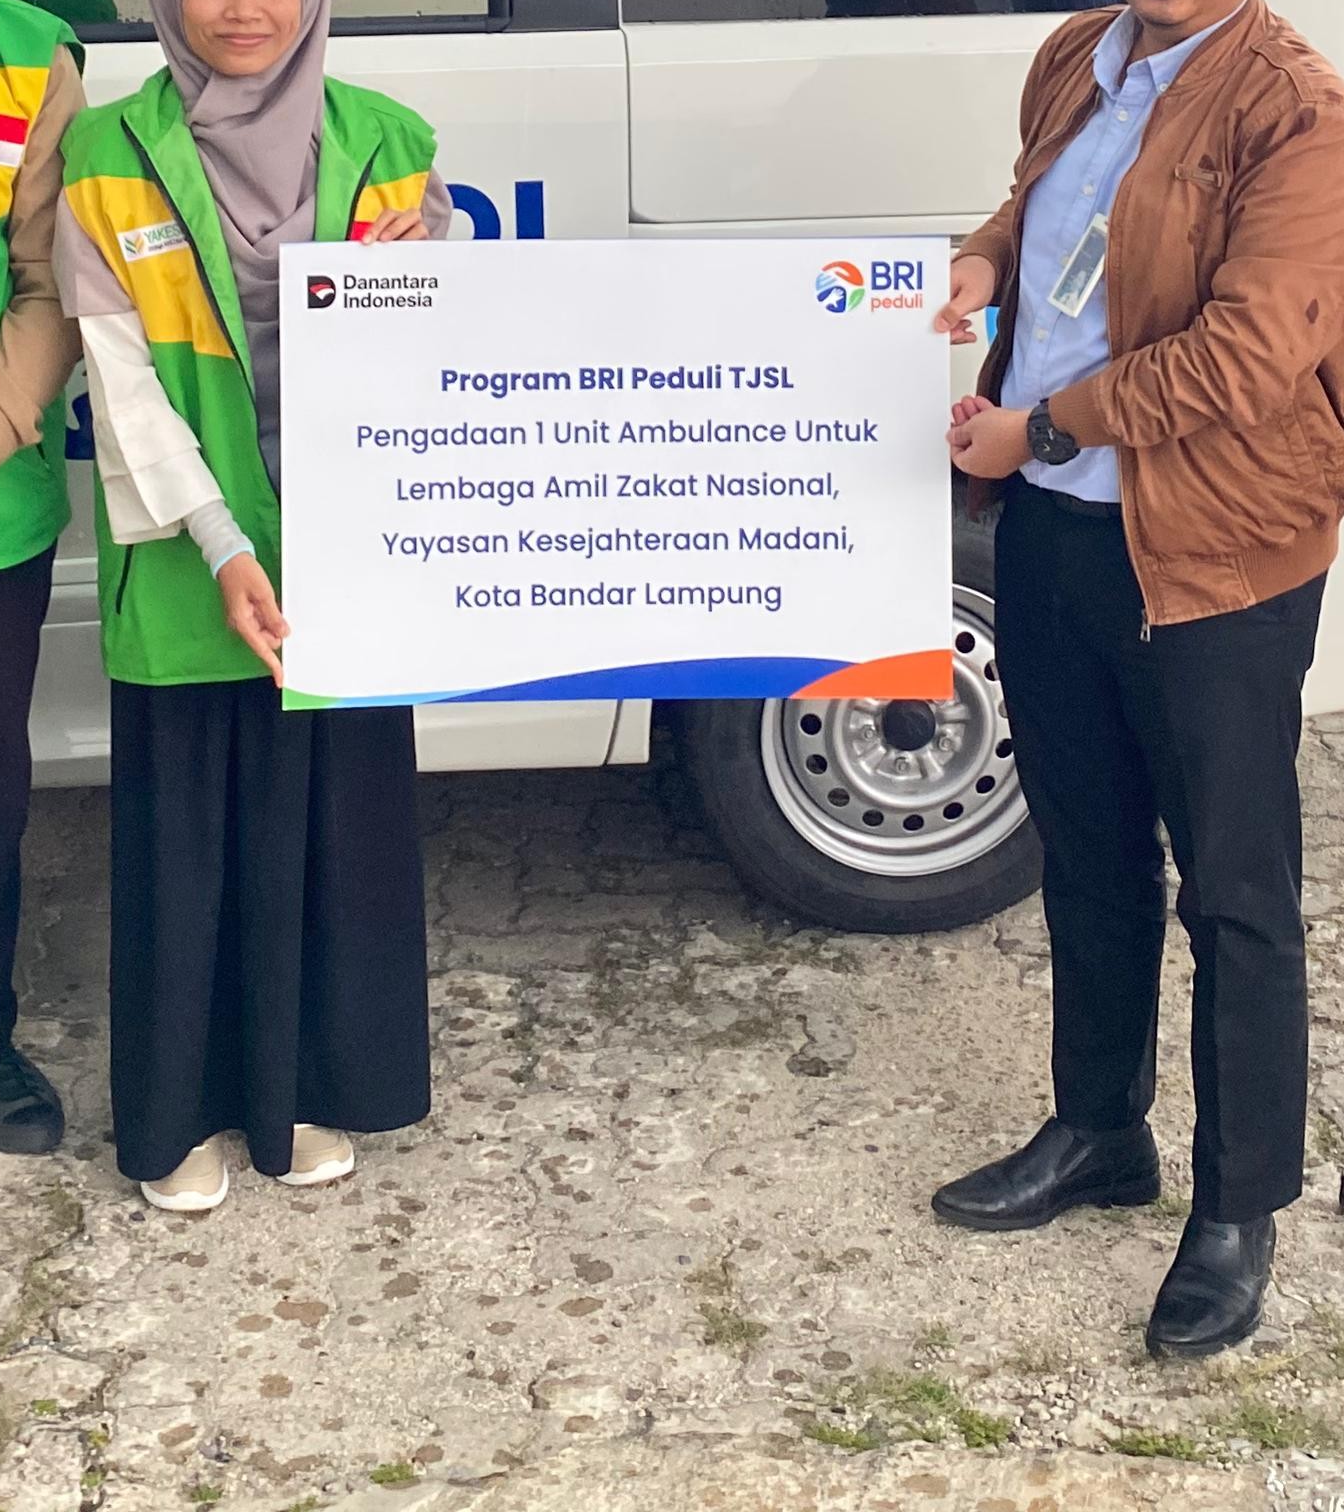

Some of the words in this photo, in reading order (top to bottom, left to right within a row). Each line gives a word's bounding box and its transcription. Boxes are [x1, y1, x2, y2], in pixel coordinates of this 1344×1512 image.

[343, 274, 438, 290] Danantara
[871, 260, 923, 291] BRI
[343, 292, 432, 308] Indonesia
[870, 293, 923, 311] peduli
[441, 369, 571, 398] Program
[579, 367, 624, 390] BRI
[631, 364, 722, 390] Peduli
[728, 366, 795, 389] TJSL
[357, 421, 527, 453] Pengadaan
[535, 421, 544, 445] 1
[554, 419, 610, 444] Unit
[617, 419, 787, 444] Ambulance
[795, 418, 879, 442] Untuk
[397, 476, 535, 505] Lembaga
[543, 473, 607, 499] Amil
[616, 473, 698, 497] Zakat
[706, 471, 840, 500] Nasional,
[381, 532, 509, 562] Yayasan
[518, 527, 729, 559] Kesejahteraan
[739, 525, 854, 554] Madani,
[456, 585, 521, 609] Kota
[531, 581, 637, 607] Bandar
[645, 582, 782, 613] Lampung
